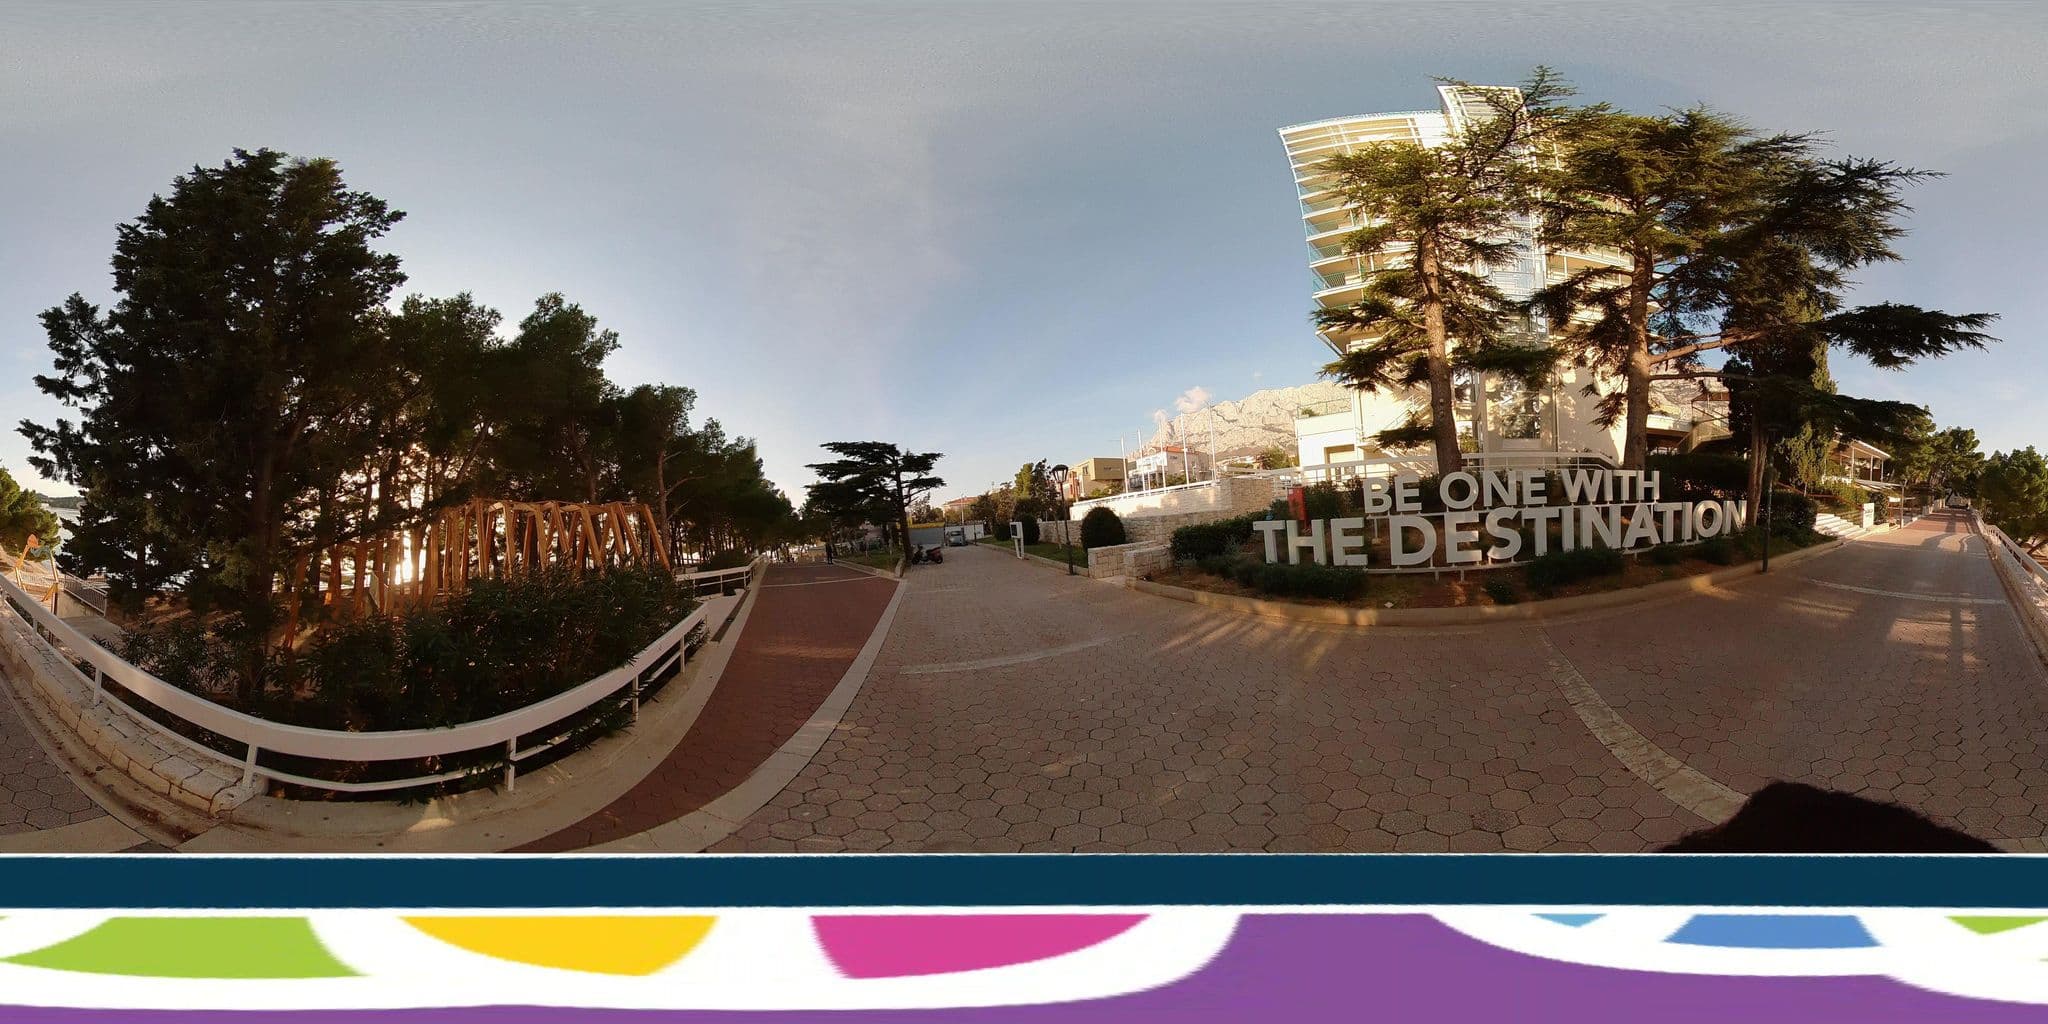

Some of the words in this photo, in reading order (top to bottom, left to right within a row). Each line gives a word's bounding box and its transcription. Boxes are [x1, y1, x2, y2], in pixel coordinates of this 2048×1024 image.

[1363, 475, 1422, 513] BE
[1440, 470, 1547, 509] ONE
[1561, 469, 1660, 503] WITH
[1253, 517, 1368, 566] THE
[1388, 500, 1747, 566] DESTINATION
